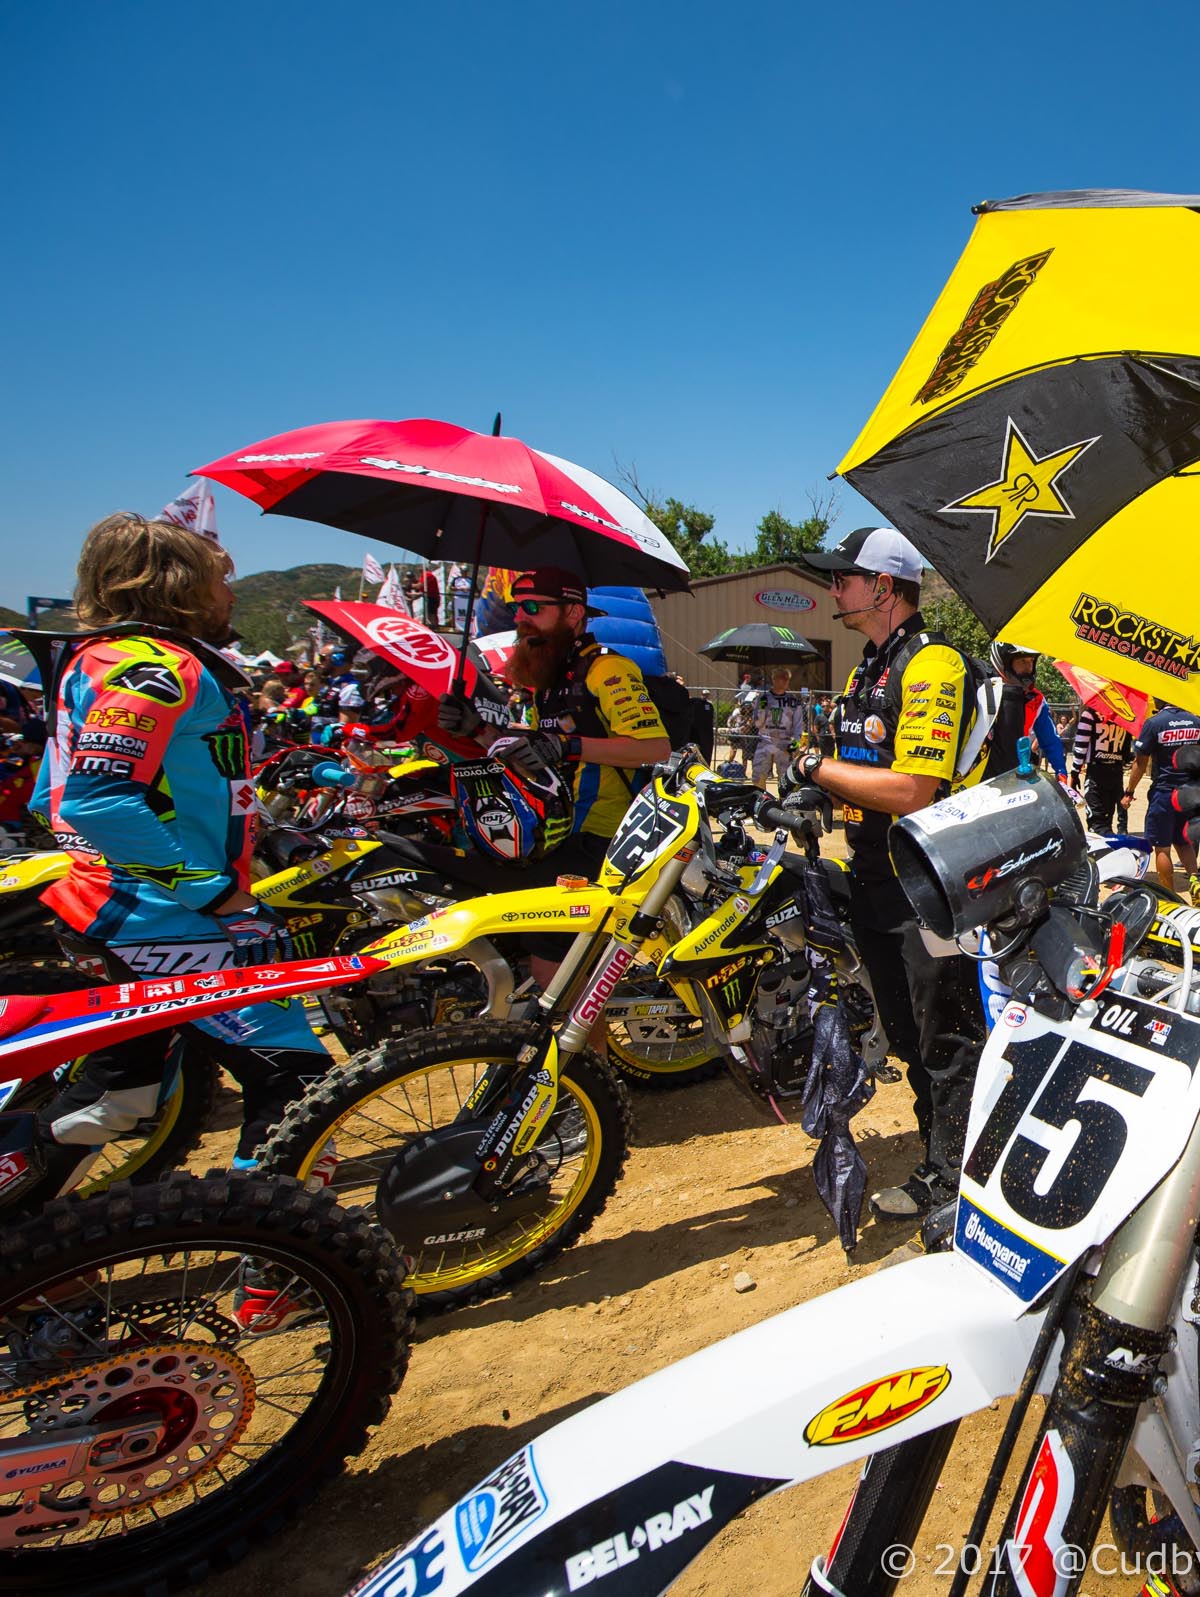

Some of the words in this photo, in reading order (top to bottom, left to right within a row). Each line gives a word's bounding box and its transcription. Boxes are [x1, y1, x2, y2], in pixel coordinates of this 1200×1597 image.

[761, 593, 782, 602] GLEN
[785, 596, 811, 605] HELEN
[1078, 624, 1142, 657] ENERGY
[1144, 651, 1190, 678] DRINK
[78, 732, 147, 750] TEXTRON
[932, 729, 951, 739] RK
[1162, 729, 1200, 742] SHOWA
[906, 746, 945, 760] JGR
[659, 802, 671, 811] OIL
[256, 870, 312, 900] Autotrader
[351, 872, 418, 892] SUZUKI
[520, 910, 566, 919] TOYOTA
[693, 912, 738, 955] Autotrader
[581, 948, 632, 1024] SHOWA
[110, 984, 264, 1022] DUNLOP
[1101, 1004, 1138, 1035] OIL
[609, 1054, 652, 1080] DUNLOP
[495, 1085, 539, 1158] DUNLOP
[963, 1031, 1156, 1230] 15
[424, 1228, 486, 1245] GALFER
[973, 1225, 1028, 1274] Husqvarna
[808, 1363, 948, 1446] FMF
[18, 1459, 67, 1475] YUTAKA
